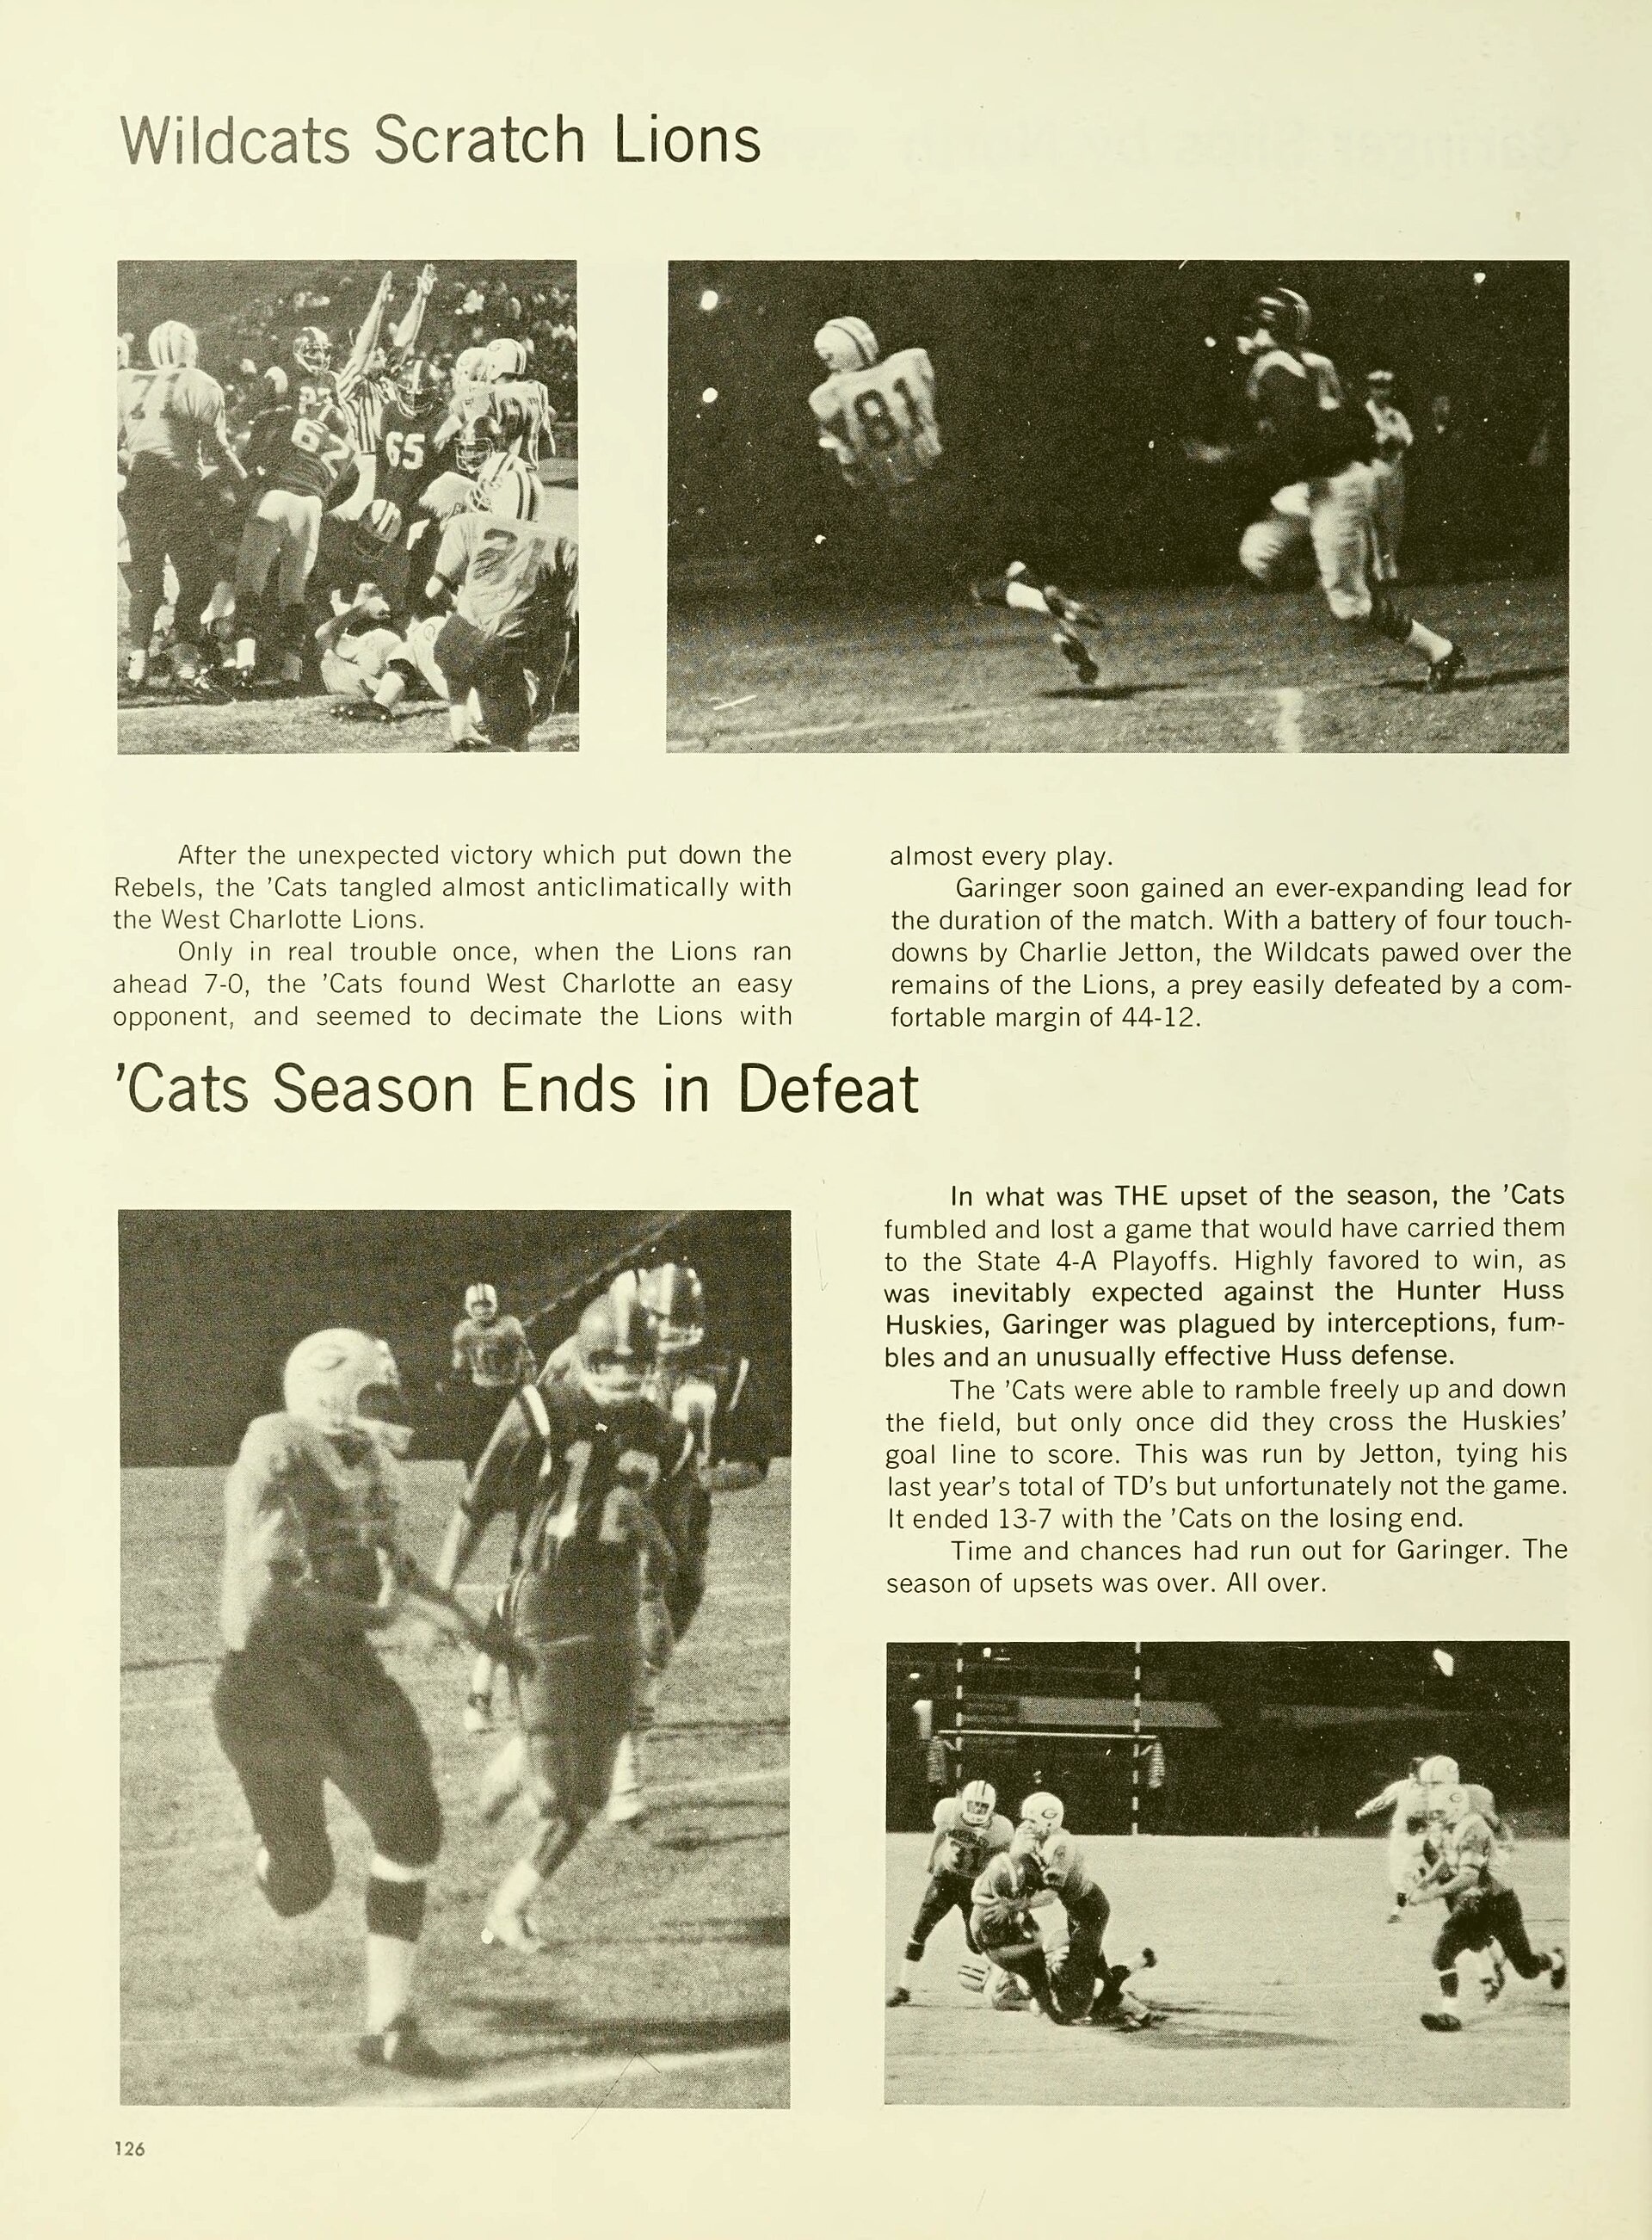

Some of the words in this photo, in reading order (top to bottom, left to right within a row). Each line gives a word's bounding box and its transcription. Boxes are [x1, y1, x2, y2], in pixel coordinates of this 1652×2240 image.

[120, 115, 350, 165] Wildcats
[375, 113, 583, 164] Scratch
[616, 113, 761, 164] Lions
[385, 431, 425, 470] 65
[177, 844, 237, 866] After
[247, 844, 286, 866] the
[299, 844, 439, 870] unexpected
[451, 843, 533, 870] victory
[543, 843, 614, 865] which
[628, 845, 667, 870] put
[679, 843, 741, 865] down
[752, 843, 792, 865] the
[890, 845, 973, 867] almost
[982, 849, 1046, 871] every
[1057, 845, 1113, 871] play.
[115, 876, 202, 901] Rebels,
[215, 877, 255, 898] the
[268, 876, 327, 898] 'Cats
[339, 876, 431, 903] tangled
[442, 876, 526, 898] almost
[537, 875, 729, 902] anticlimatically
[739, 875, 791, 897] with
[956, 877, 1063, 904] Garinger
[1073, 882, 1129, 898] soon
[1140, 877, 1224, 904] gained
[1235, 882, 1264, 898] an
[1276, 876, 1464, 903] ever-expanding
[1477, 876, 1527, 898] lead
[1538, 876, 1573, 898] for
[113, 909, 151, 929] the
[161, 909, 220, 929] West
[229, 908, 342, 929] Charlotte
[353, 908, 423, 929] Lions.
[891, 941, 968, 963] downs
[980, 941, 1008, 968] by
[1020, 941, 1106, 963] Charlie
[1118, 941, 1201, 966] Jetton,
[1213, 941, 1252, 963] the
[1263, 941, 1370, 963] Wildcats
[1382, 941, 1458, 968] pawed
[1470, 946, 1523, 963] over
[1532, 941, 1572, 963] the
[113, 973, 187, 994] ahead
[204, 972, 250, 998] 7-0,
[267, 973, 306, 994] the
[323, 972, 383, 994] 'Cats
[398, 972, 470, 994] found
[486, 972, 546, 994] West
[563, 972, 675, 994] Charlotte
[692, 978, 720, 993] an
[737, 978, 793, 998] easy
[113, 1006, 234, 1032] opponent,
[254, 1005, 298, 1026] and
[316, 1005, 410, 1027] seemed
[428, 1006, 451, 1026] to
[470, 1004, 582, 1026] decimate
[600, 1005, 639, 1026] the
[658, 1004, 723, 1026] Lions
[740, 1004, 792, 1026] with
[891, 1006, 986, 1027] fortable
[996, 1006, 1080, 1033] margin
[1089, 1006, 1113, 1027] of
[1121, 1006, 1201, 1027] 44-12.
[116, 1061, 249, 1114] 'Cats
[274, 1062, 472, 1114] Season
[503, 1062, 636, 1113] Ends
[665, 1062, 708, 1113] in
[741, 1062, 919, 1114] Defeat
[952, 1185, 972, 1206] In
[985, 1186, 1045, 1207] what
[1057, 1190, 1103, 1206] was
[1114, 1184, 1168, 1206] THE
[1180, 1186, 1248, 1212] upset
[1259, 1184, 1283, 1206] of
[1294, 1184, 1334, 1206] the
[1347, 1188, 1438, 1209] season,
[1451, 1183, 1491, 1206] the
[1503, 1182, 1565, 1206] 'Cats
[885, 1252, 908, 1272] to
[922, 1251, 962, 1272] the
[977, 1250, 1040, 1272] State
[1056, 1250, 1097, 1272] 4-A
[1113, 1250, 1217, 1276] Playoffs.
[1236, 1250, 1313, 1276] Highly
[1328, 1249, 1420, 1270] favored
[1433, 1250, 1458, 1270] to
[1472, 1248, 1523, 1274] win,
[1538, 1253, 1566, 1269] as
[884, 1287, 930, 1304] was
[952, 1281, 1071, 1308] inevitably
[1092, 1280, 1203, 1307] expected
[1224, 1280, 1315, 1307] against
[1335, 1280, 1374, 1301] the
[1397, 1279, 1482, 1301] Hunter
[1503, 1279, 1564, 1300] Huss
[886, 1313, 989, 1339] Huskies,
[1002, 1313, 1109, 1340] Garinger
[1119, 1317, 1166, 1335] was
[1179, 1311, 1275, 1339] plagued
[1287, 1312, 1315, 1339] by
[1328, 1311, 1496, 1338] interceptions,
[1507, 1311, 1565, 1332] fum-
[885, 1346, 935, 1368] bles
[943, 1346, 989, 1367] and
[997, 1351, 1026, 1367] an
[1037, 1345, 1156, 1372] unusually
[1164, 1344, 1271, 1367] effective
[1281, 1344, 1342, 1366] Huss
[1351, 1343, 1454, 1366] defense.
[885, 1412, 925, 1433] the
[938, 1411, 1001, 1436] field,
[1017, 1411, 1057, 1433] but
[1070, 1411, 1122, 1437] only
[1136, 1416, 1194, 1432] once
[1210, 1410, 1248, 1432] did
[1262, 1410, 1315, 1437] they
[1328, 1416, 1394, 1432] cross
[1408, 1410, 1447, 1431] the
[1464, 1409, 1567, 1431] Huskies'
[888, 1476, 932, 1497] last
[939, 1475, 1010, 1502] year's
[1019, 1476, 1073, 1496] total
[1082, 1475, 1106, 1496] of
[1113, 1475, 1168, 1496] TD's
[1176, 1475, 1217, 1496] but
[1225, 1475, 1392, 1501] unfortunately
[1400, 1475, 1439, 1496] not
[1446, 1474, 1485, 1496] the
[1493, 1478, 1567, 1500] game.
[950, 1540, 1012, 1561] Time
[1023, 1540, 1069, 1561] and
[1081, 1540, 1181, 1561] chances
[1194, 1540, 1238, 1561] had
[1250, 1545, 1290, 1561] run
[1302, 1540, 1342, 1561] out
[1352, 1539, 1386, 1560] for
[1397, 1538, 1510, 1564] Garinger.
[1522, 1538, 1568, 1559] The
[886, 1577, 970, 1594] season
[979, 1571, 1003, 1594] of
[1014, 1573, 1094, 1598] upsets
[1101, 1577, 1149, 1593] was
[1156, 1577, 1216, 1593] over.
[1226, 1571, 1257, 1593] All
[1267, 1577, 1326, 1593] over.
[115, 2141, 145, 2157] 126
